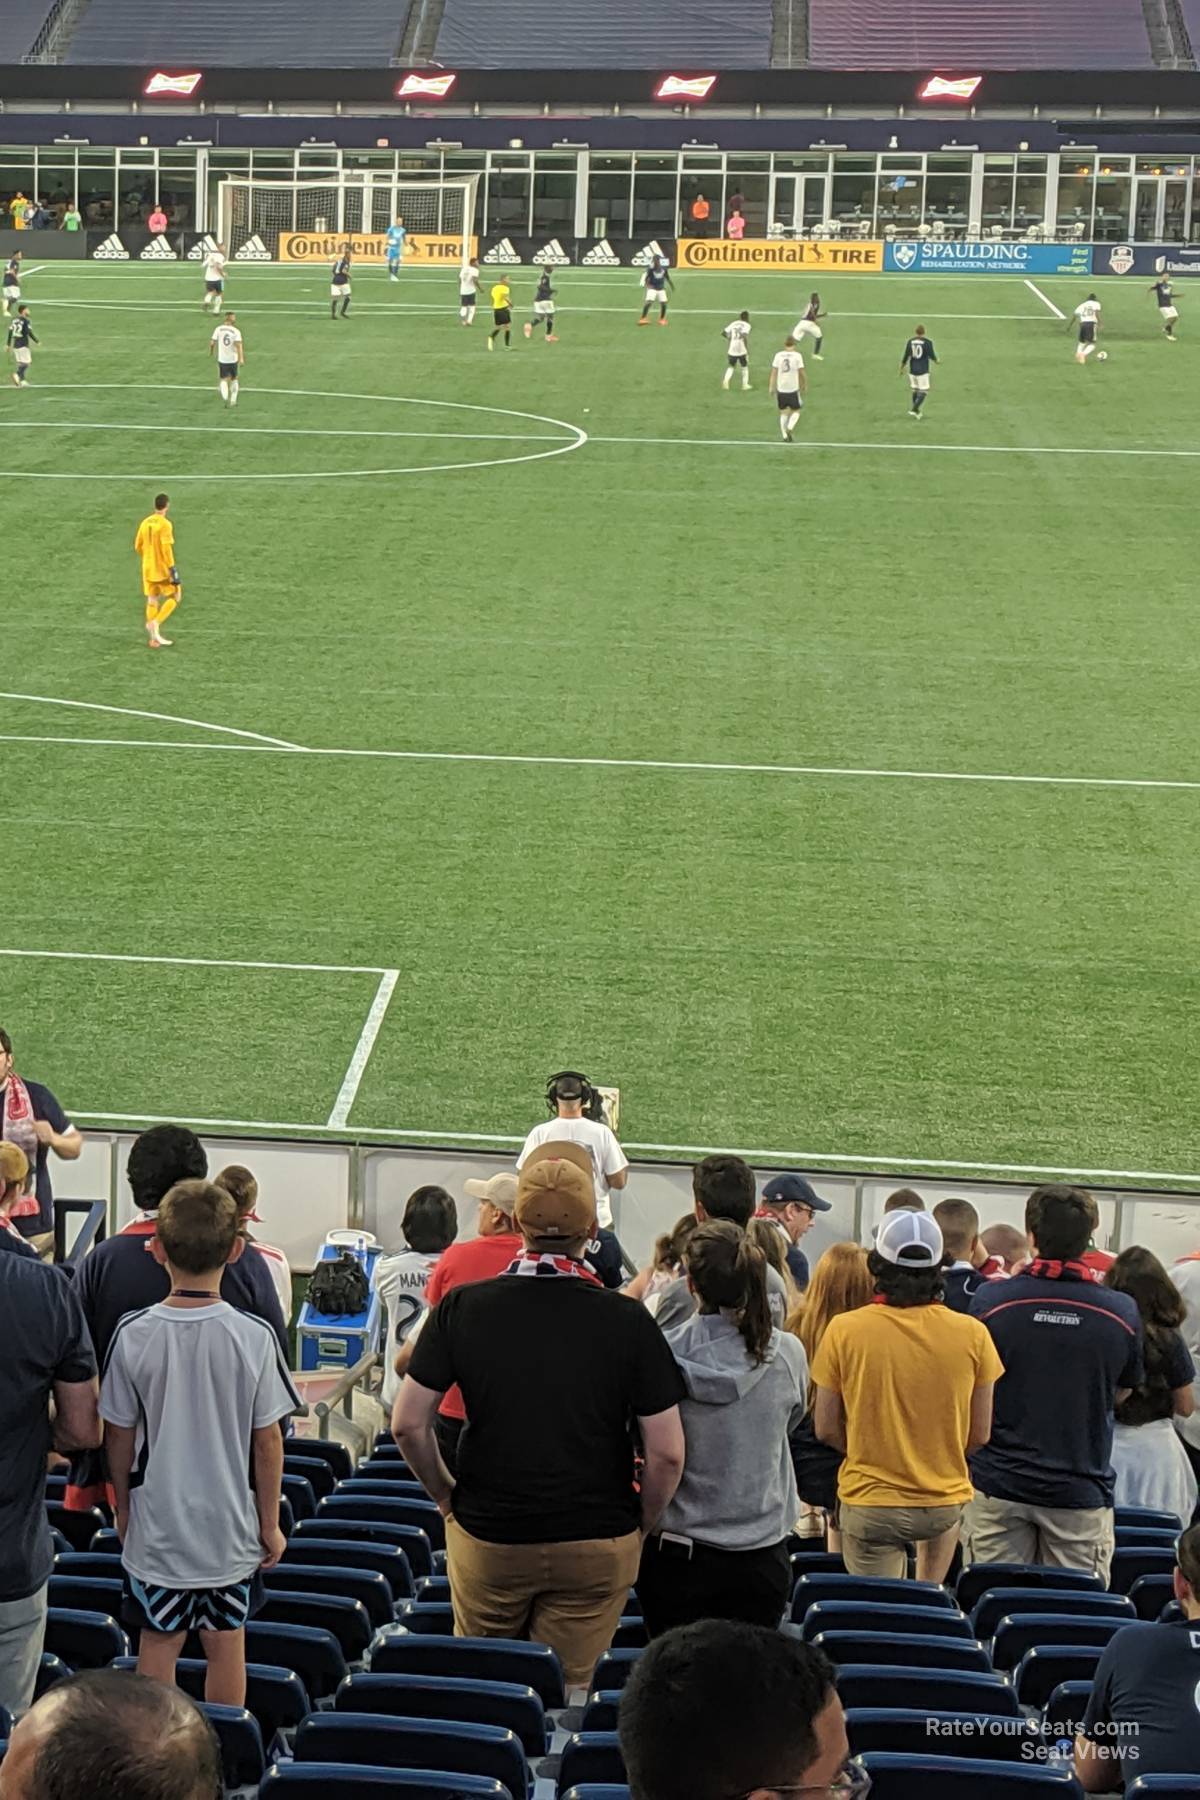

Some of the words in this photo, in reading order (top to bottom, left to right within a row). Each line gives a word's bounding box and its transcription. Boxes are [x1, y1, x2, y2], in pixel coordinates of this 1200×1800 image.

[93, 250, 130, 260] adidas
[140, 250, 177, 260] adidas
[235, 251, 272, 260] adidas
[684, 241, 804, 266] Continental
[829, 249, 876, 264] TIRE
[922, 243, 1028, 259] SPAULDING
[484, 255, 522, 264] adidas
[533, 256, 570, 265] adidas
[582, 256, 620, 265] adidas
